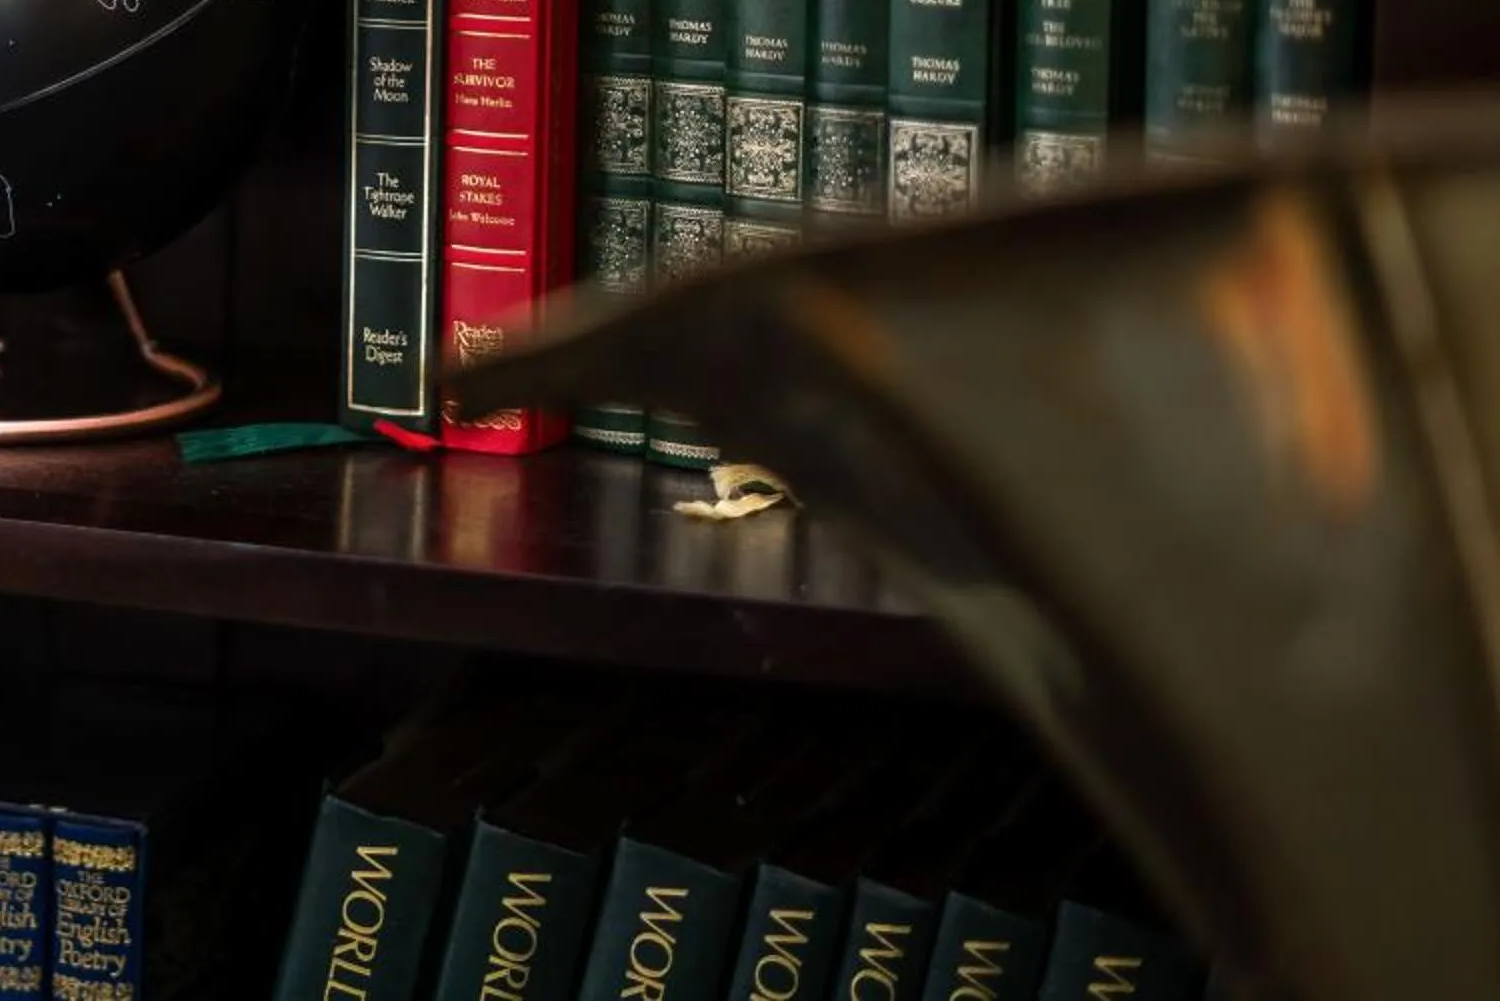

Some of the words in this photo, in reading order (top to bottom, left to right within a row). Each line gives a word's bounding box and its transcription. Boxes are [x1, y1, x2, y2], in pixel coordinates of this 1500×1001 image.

[668, 18, 713, 33] THOMAS
[669, 32, 710, 45] HARDY
[744, 35, 789, 49] THOMAS
[744, 47, 786, 62] HARDY
[368, 56, 414, 73] Shadow
[472, 57, 497, 71] THE
[911, 56, 961, 72] THOMAS
[373, 72, 387, 87] of
[388, 73, 406, 88] the
[912, 70, 957, 85] HARDY
[373, 88, 410, 103] Moon
[373, 172, 401, 188] The
[460, 174, 501, 189] ROYAL
[361, 186, 416, 205] Tightrope
[459, 191, 504, 206] STAKES
[369, 202, 408, 220] Walker
[362, 326, 409, 347] Reader's
[364, 345, 405, 366] Digest
[56, 878, 131, 904] OXFORD
[108, 903, 129, 918] OF
[55, 911, 132, 948] English
[58, 938, 127, 978] Poetry
[749, 909, 813, 1001] WO
